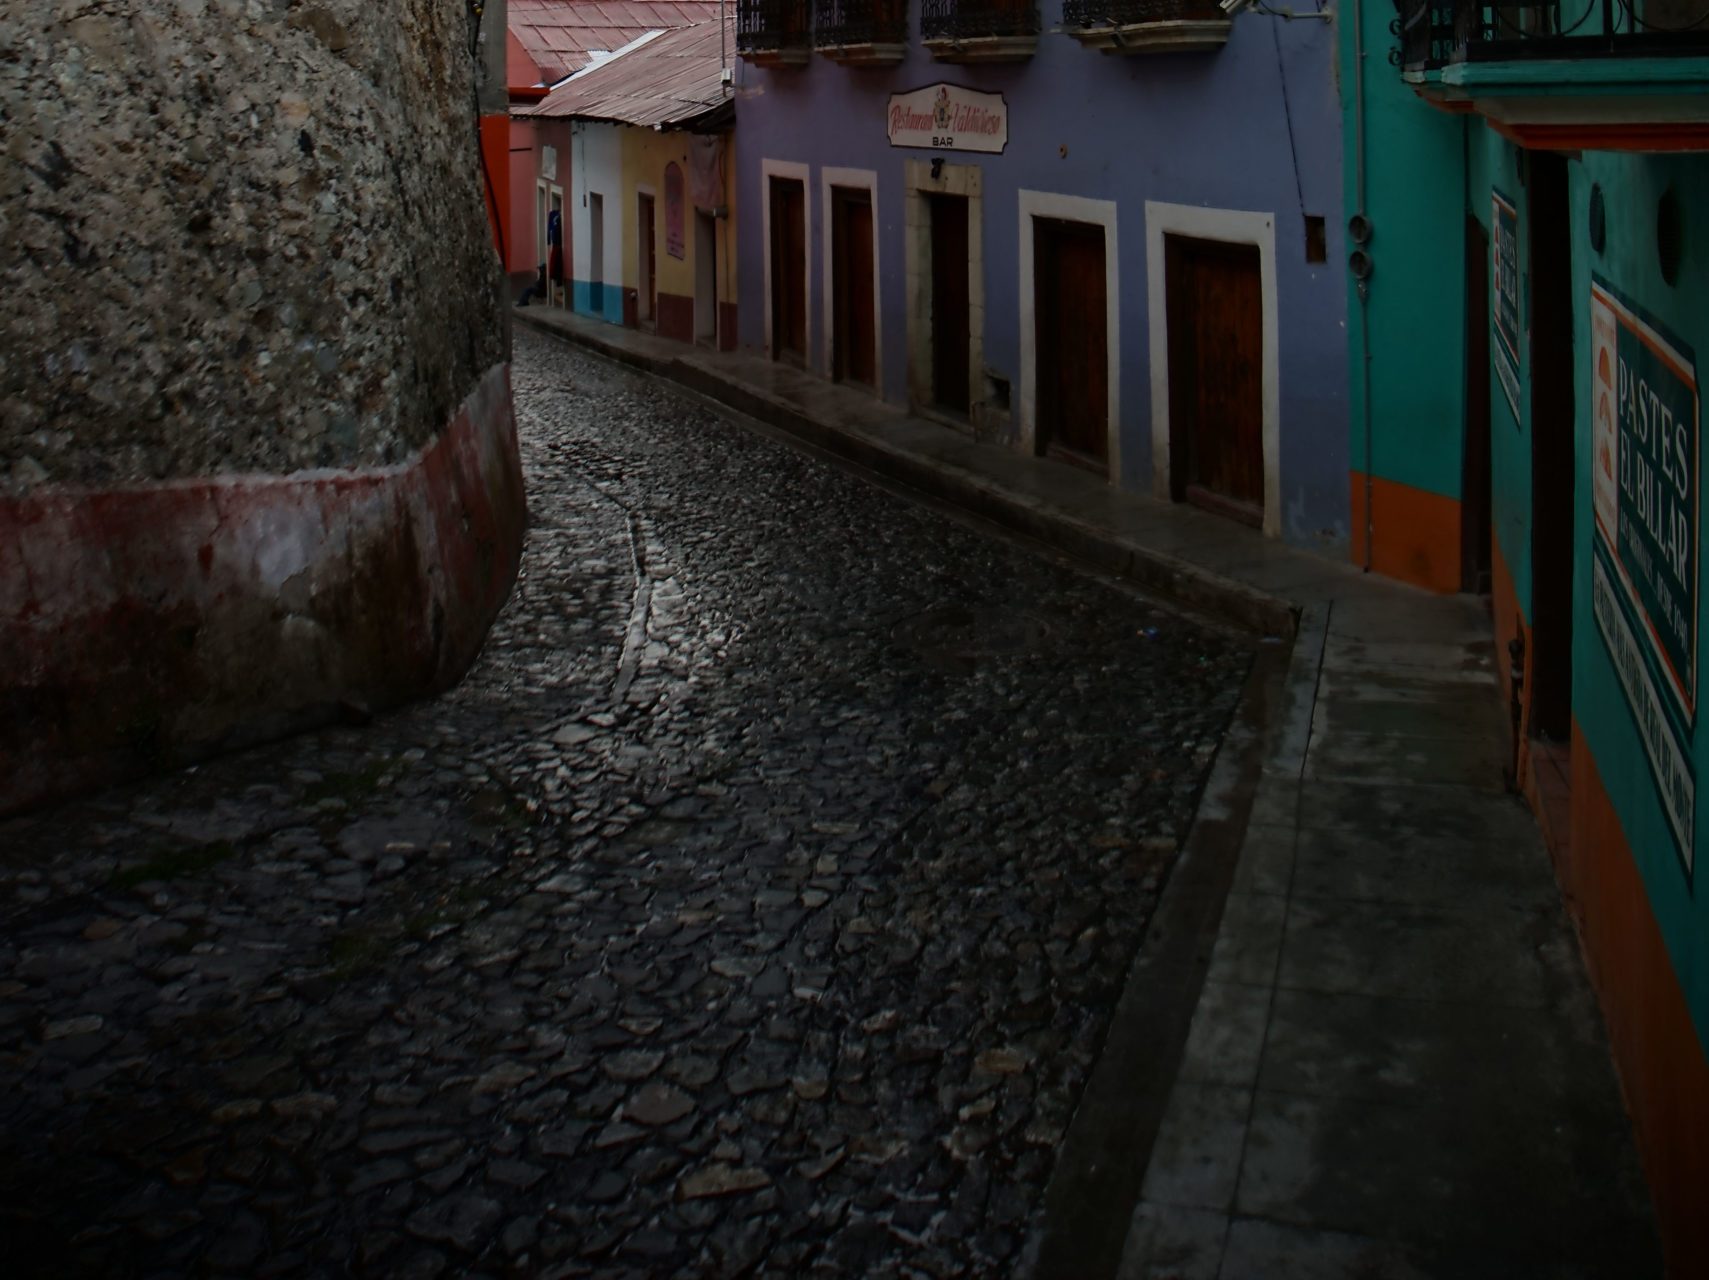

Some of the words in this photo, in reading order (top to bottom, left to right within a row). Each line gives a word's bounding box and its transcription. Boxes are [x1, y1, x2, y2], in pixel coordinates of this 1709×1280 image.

[890, 104, 936, 136] Restaurant
[932, 136, 954, 147] BAR
[1619, 355, 1688, 501] PASTES
[1620, 426, 1634, 503] EL
[1637, 450, 1688, 592] BILLAR
[1657, 570, 1673, 627] DESDE
[1662, 734, 1671, 796] DEL
[1673, 766, 1691, 848] MONTE
